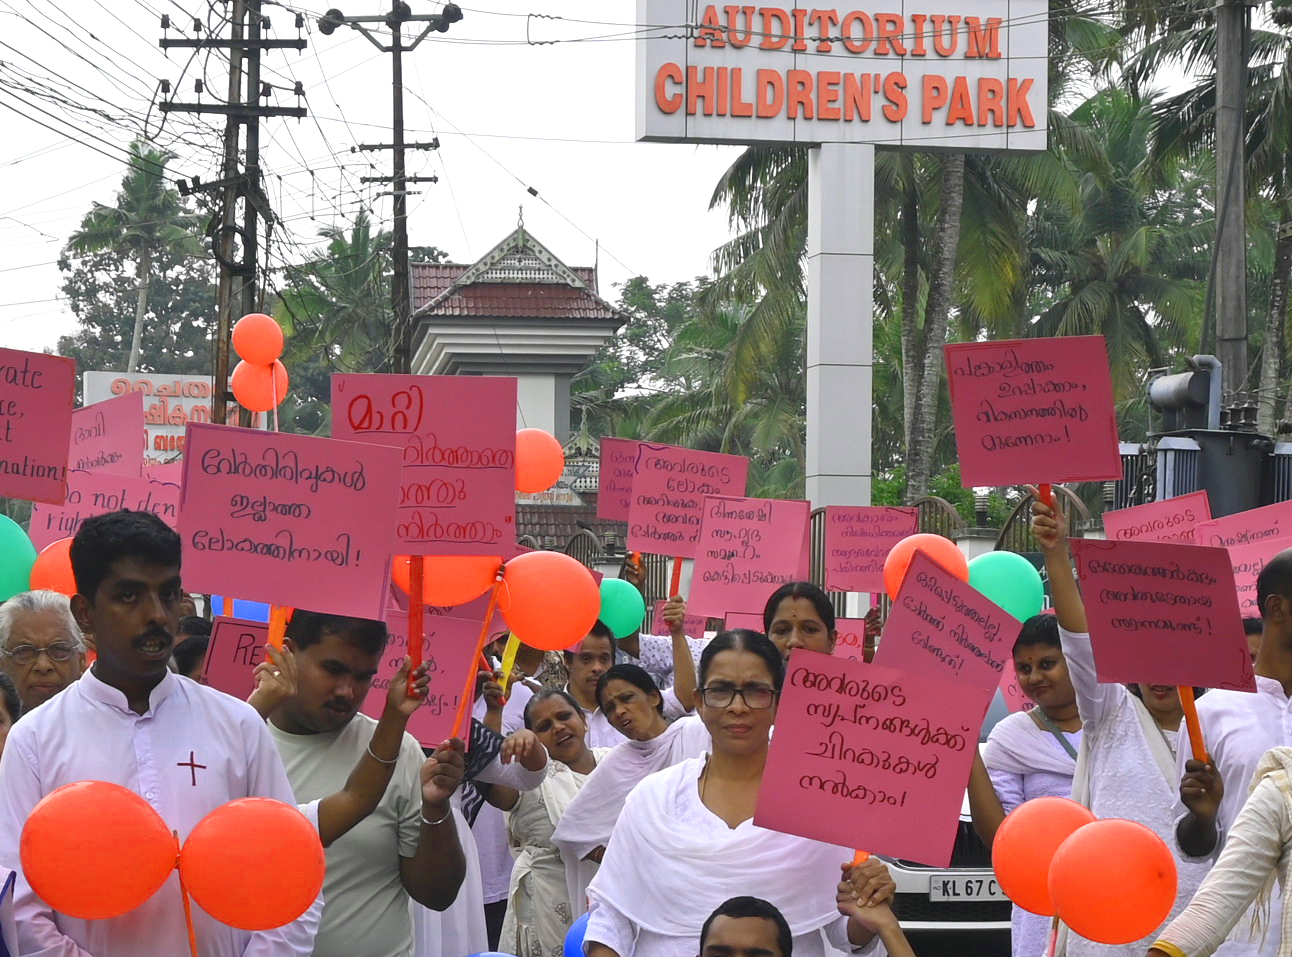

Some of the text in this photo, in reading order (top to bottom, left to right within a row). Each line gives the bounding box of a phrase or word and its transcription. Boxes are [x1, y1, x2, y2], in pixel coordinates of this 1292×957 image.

[693, 4, 1002, 59] AUDITORIUM
[654, 62, 1035, 128] CHILDREN'S PARK
[92, 488, 128, 510] not
[137, 491, 176, 517] den
[46, 511, 94, 538] righ
[791, 666, 906, 707] അവരുടെ
[805, 730, 939, 779] ചിറകുകൾ
[942, 880, 961, 897] KL
[965, 879, 984, 896] 67
